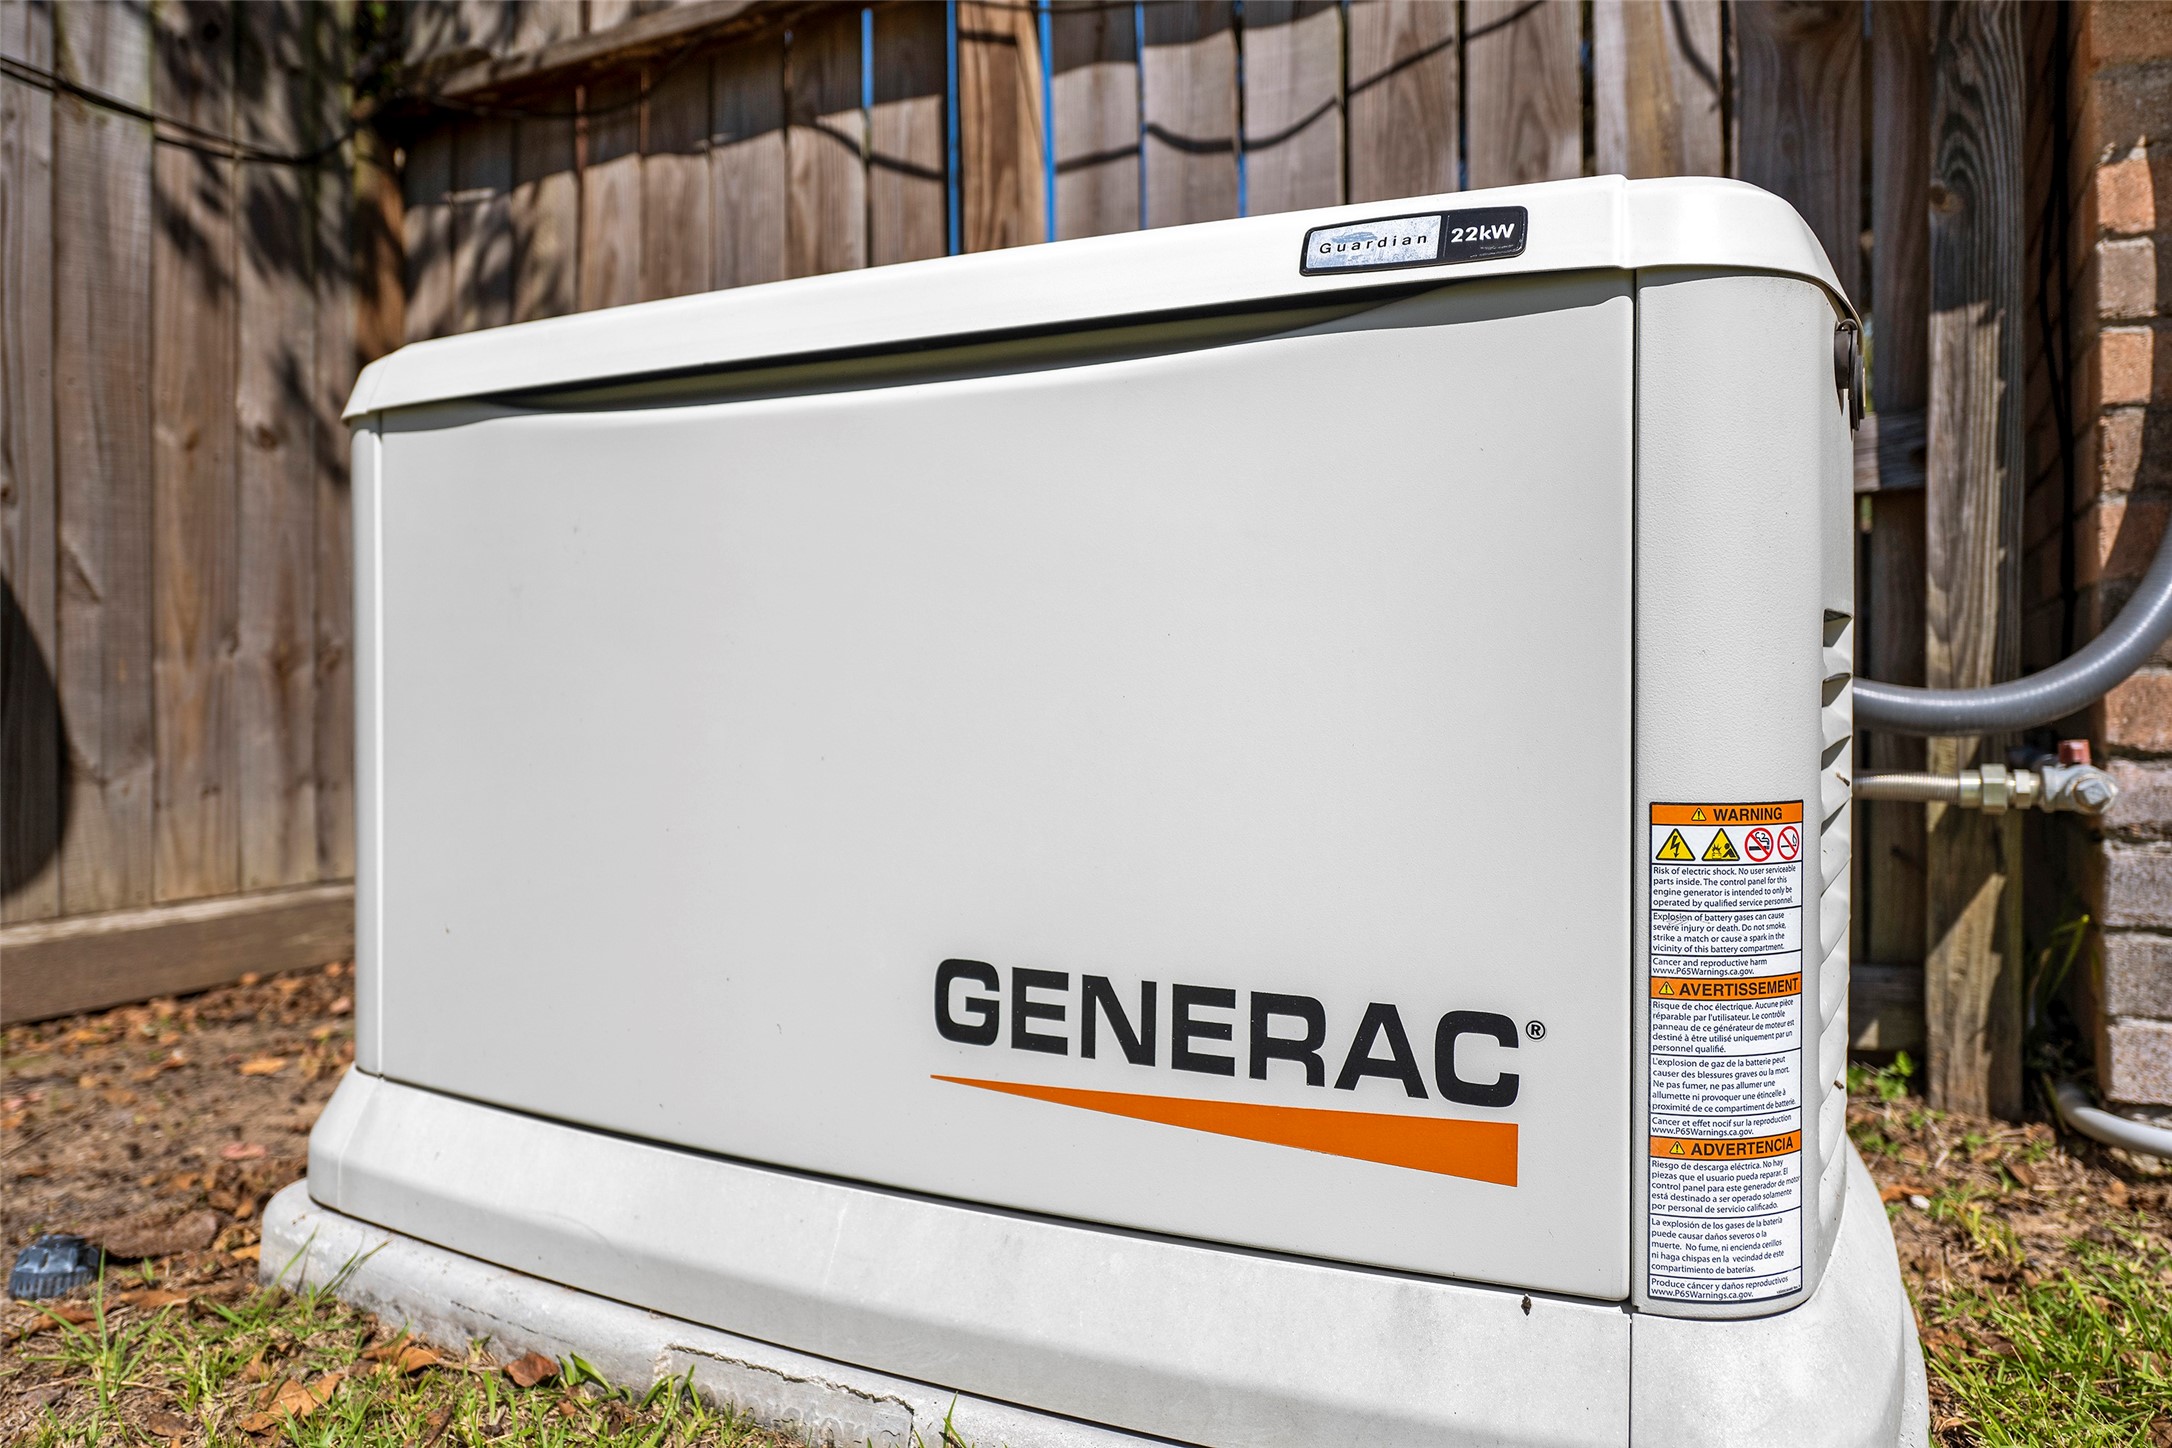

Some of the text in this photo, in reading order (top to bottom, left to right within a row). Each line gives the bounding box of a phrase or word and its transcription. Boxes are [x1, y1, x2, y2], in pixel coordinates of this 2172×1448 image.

[1319, 223, 1516, 254] Guardian 22kW
[1713, 808, 1782, 821] WARNING
[1654, 877, 1766, 886] parts inside. The control panel
[1653, 888, 1763, 898] engine generator intended
[1653, 900, 1690, 908] operated
[1692, 899, 1702, 908] by
[1704, 899, 1737, 908] qualified
[1654, 913, 1692, 923] Explosion
[1705, 914, 1732, 923] battery
[1734, 915, 1753, 923] gases
[1681, 924, 1704, 933] injury
[1716, 924, 1740, 932] death.
[1750, 934, 1767, 943] spark
[1653, 945, 1682, 953] vicinity
[1711, 945, 1738, 954] battery
[1653, 958, 1680, 966] Cancer
[1700, 959, 1748, 968] reproductive
[1653, 968, 1754, 977] www.P65Warnings.ca.gov.
[1679, 978, 1798, 996] AVERTISSEMENT
[1653, 1002, 1679, 1011] Risque
[1694, 1003, 1713, 1011] choc
[1716, 1002, 1753, 1011] électrique.
[1653, 1013, 1691, 1021] réparable
[1693, 1014, 1706, 1023] par
[1709, 1013, 1750, 1022] l'utilisateur.
[934, 957, 1521, 1108] GENERAC
[1653, 1024, 1688, 1033] panneau
[1691, 1024, 1700, 1032] de
[1714, 1024, 1753, 1033] générateur
[1691, 1034, 1707, 1042] être
[1709, 1034, 1732, 1042] utilisé
[1734, 1033, 1774, 1043] uniquement
[1653, 1045, 1726, 1054] personnel qualifié.
[1653, 1058, 1771, 1069] L'explosion de gaz de batterie
[1681, 1070, 1695, 1078] des
[1698, 1071, 1733, 1079] blessures
[1735, 1071, 1757, 1080] graves
[1682, 1082, 1708, 1090] fumer,
[1722, 1083, 1735, 1091] pas
[1652, 1091, 1690, 1100] allumette
[1702, 1094, 1740, 1102] provoquer
[1652, 1103, 1690, 1112] proximité
[1715, 1104, 1765, 1113] compartiment
[1692, 1119, 1711, 1127] effet
[1713, 1119, 1731, 1127] nocif
[1652, 1127, 1753, 1137] www.P65Warnings.ca.gov.
[1691, 1137, 1793, 1155] ADVERTENCIA
[1652, 1160, 1679, 1170] Riesgo
[1693, 1163, 1728, 1171] descarga
[1730, 1162, 1761, 1170] eléctrica.
[1652, 1171, 1677, 1180] piezas
[1679, 1174, 1694, 1182] que
[1736, 1173, 1758, 1182] pueda
[1683, 1184, 1705, 1192] panel
[1671, 1193, 1710, 1202] destinado
[1732, 1195, 1761, 1204] operado
[1668, 1204, 1702, 1213] personal
[1705, 1205, 1715, 1213] de
[1717, 1205, 1745, 1213] servicio
[1663, 1221, 1699, 1230] explosión
[1652, 1230, 1676, 1238] puede
[1652, 1242, 1681, 1250] muerte.
[1699, 1244, 1720, 1252] fume,
[1730, 1243, 1760, 1251] encienda
[1661, 1253, 1680, 1262] haga
[1682, 1255, 1710, 1263] chispas
[1733, 1254, 1763, 1262] vecindad
[1652, 1264, 1714, 1274] compartimiento
[1652, 1279, 1685, 1288] Produce
[1651, 1288, 1753, 1299] www.P65Warnings.ca.gov.
